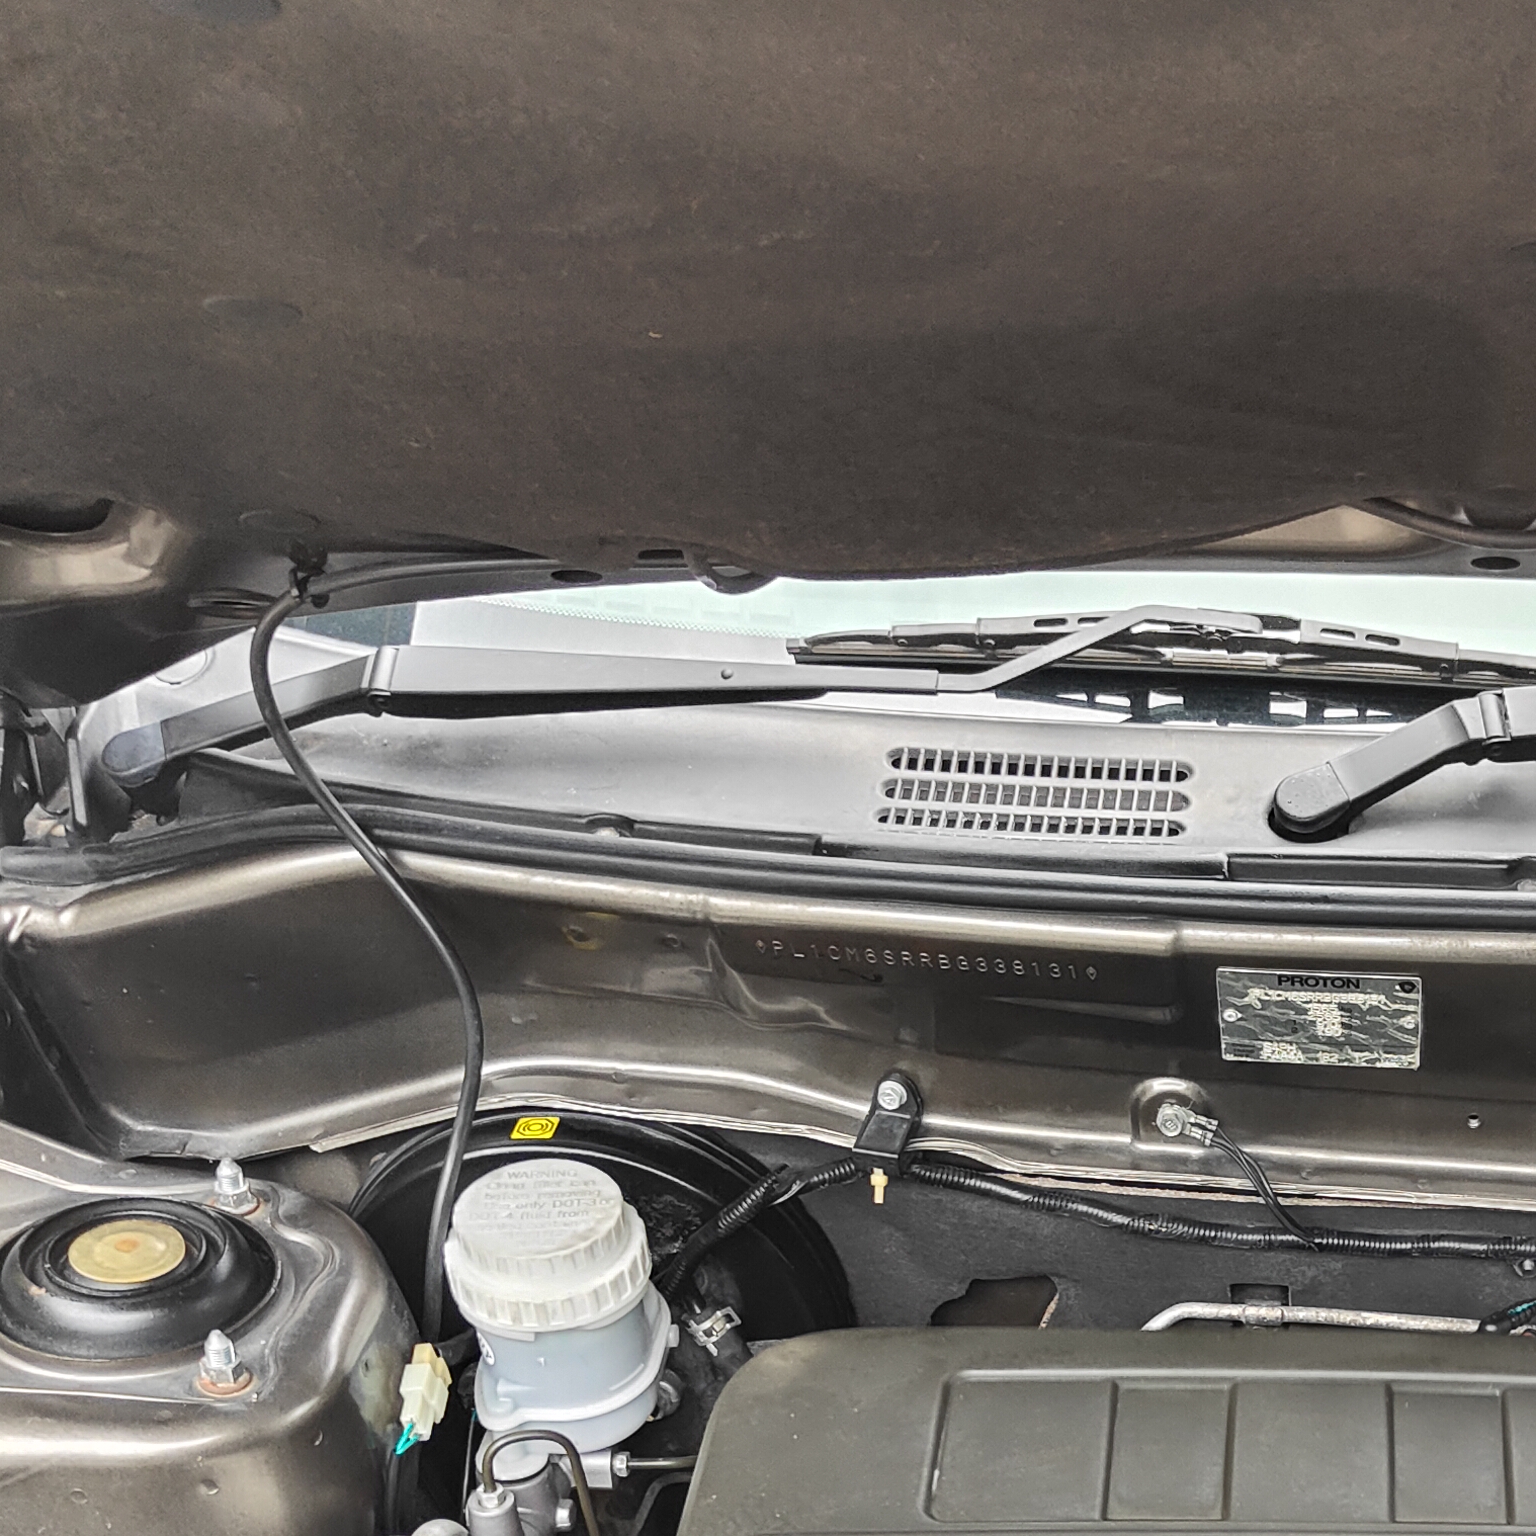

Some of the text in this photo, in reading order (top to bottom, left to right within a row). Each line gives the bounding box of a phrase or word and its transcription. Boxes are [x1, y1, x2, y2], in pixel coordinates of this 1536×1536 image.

[772, 940, 1077, 979] PL1CM6SRRBG338131
[1277, 975, 1361, 989] PROTON
[507, 1169, 578, 1179] WARNING
